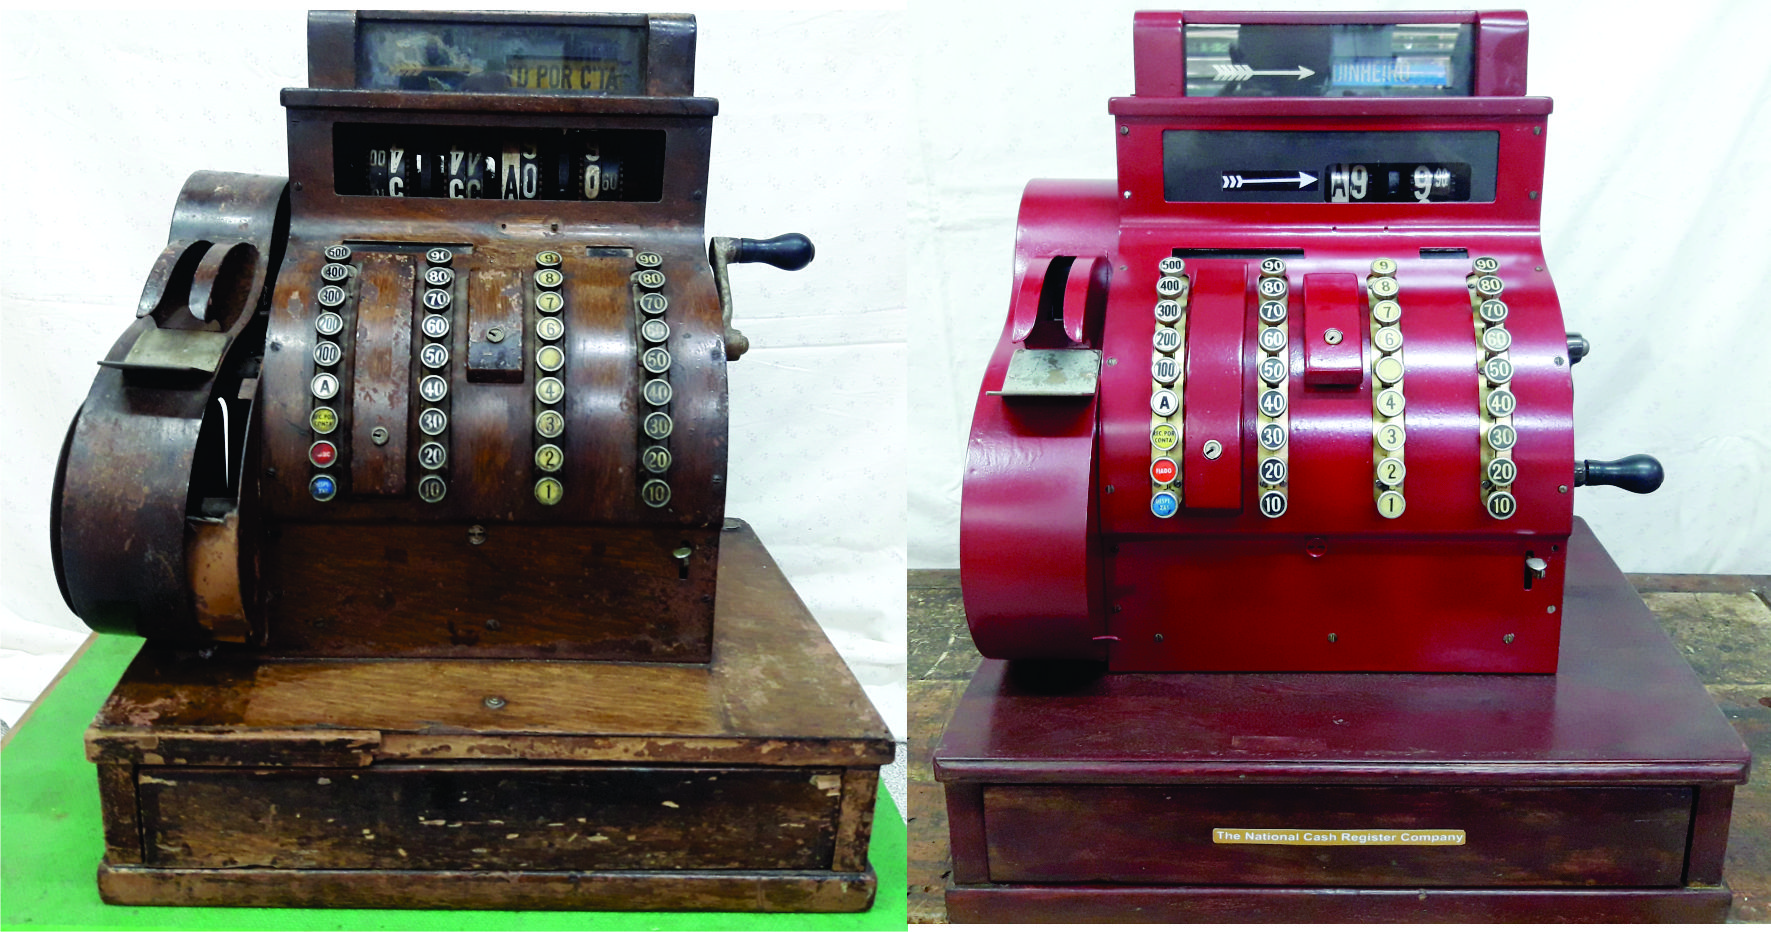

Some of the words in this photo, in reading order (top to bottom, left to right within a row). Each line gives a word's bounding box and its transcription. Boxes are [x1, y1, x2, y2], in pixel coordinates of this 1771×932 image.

[536, 65, 572, 89] POR
[430, 252, 447, 260] 90
[639, 255, 658, 264] 90
[1162, 260, 1181, 270] 500
[1264, 260, 1283, 271] 90
[1380, 261, 1389, 271] 9
[1476, 259, 1496, 270] 90
[327, 268, 343, 277] 400
[428, 271, 447, 281] 80
[546, 273, 554, 283] 8
[642, 274, 661, 284] 80
[1160, 280, 1180, 291] 400
[1264, 281, 1283, 293] 80
[1382, 281, 1390, 292] 8
[1480, 279, 1500, 291] 80
[324, 290, 339, 302] 300
[428, 293, 446, 306] 70
[546, 297, 555, 310] 7
[644, 298, 664, 310] 70
[1158, 304, 1178, 317] 300
[1484, 303, 1504, 317] 70
[1264, 305, 1283, 318] 70
[1383, 306, 1392, 318] 7
[319, 318, 338, 330] 200
[426, 319, 446, 333] 60
[546, 322, 555, 336] 6
[1156, 333, 1177, 347] 200
[1264, 332, 1283, 346] 60
[1385, 333, 1394, 346] 6
[1486, 333, 1507, 347] 60
[318, 348, 335, 361] 100
[426, 349, 444, 363] 50
[647, 352, 667, 367] 50
[1156, 362, 1175, 378] 100
[1264, 362, 1283, 378] 50
[1489, 362, 1509, 378] 50
[320, 379, 331, 393] A
[424, 382, 443, 397] 40
[545, 383, 555, 398] 4
[648, 385, 668, 400] 40
[1159, 395, 1170, 410] A
[1263, 395, 1283, 411] 40
[1386, 394, 1396, 410] 4
[1491, 395, 1512, 412] 40
[424, 414, 442, 429] 30
[546, 416, 555, 433] 3
[650, 419, 668, 434] 30
[1263, 428, 1283, 445] 30
[1387, 429, 1397, 445] 3
[1492, 428, 1513, 445] 30
[424, 448, 442, 464] 20
[545, 451, 555, 467] 2
[650, 451, 668, 468] 20
[1264, 463, 1283, 479] 20
[1387, 464, 1397, 479] 2
[1492, 464, 1512, 480] 20
[425, 482, 440, 498] 10
[650, 486, 665, 501] 10
[1265, 497, 1282, 513] 10
[1494, 497, 1510, 514] 10
[1216, 831, 1241, 840] The
[1244, 832, 1299, 842] National
[1303, 832, 1337, 842] Cash
[1341, 832, 1396, 844] Register
[1400, 833, 1463, 844] Company
